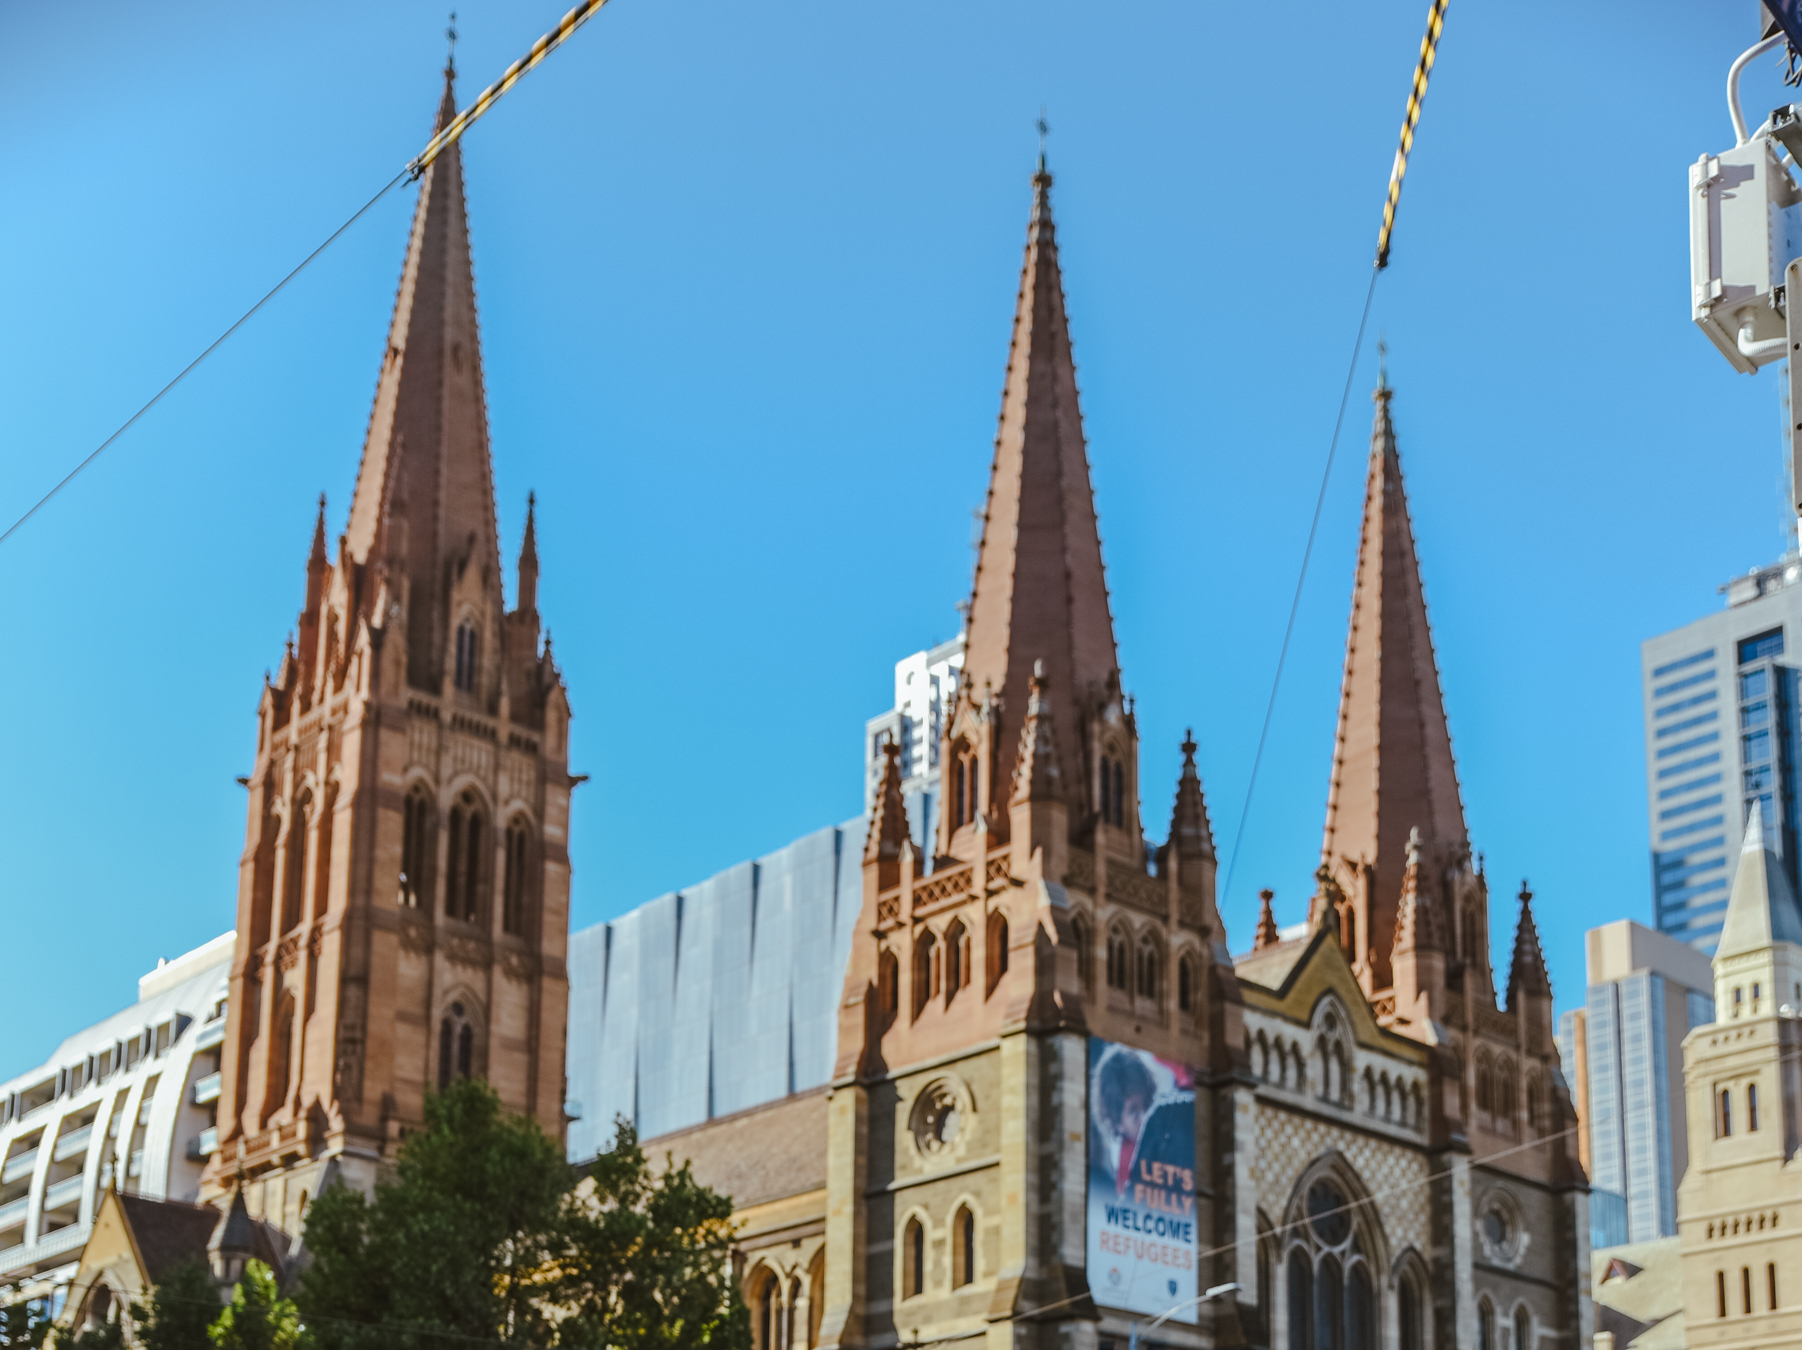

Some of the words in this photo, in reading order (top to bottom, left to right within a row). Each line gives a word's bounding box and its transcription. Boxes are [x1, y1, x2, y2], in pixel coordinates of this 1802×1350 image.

[1139, 1159, 1194, 1191] LET'S
[1134, 1183, 1194, 1215] FULLY
[1104, 1203, 1192, 1244] WELCOME
[1099, 1231, 1193, 1270] REFUGEES
